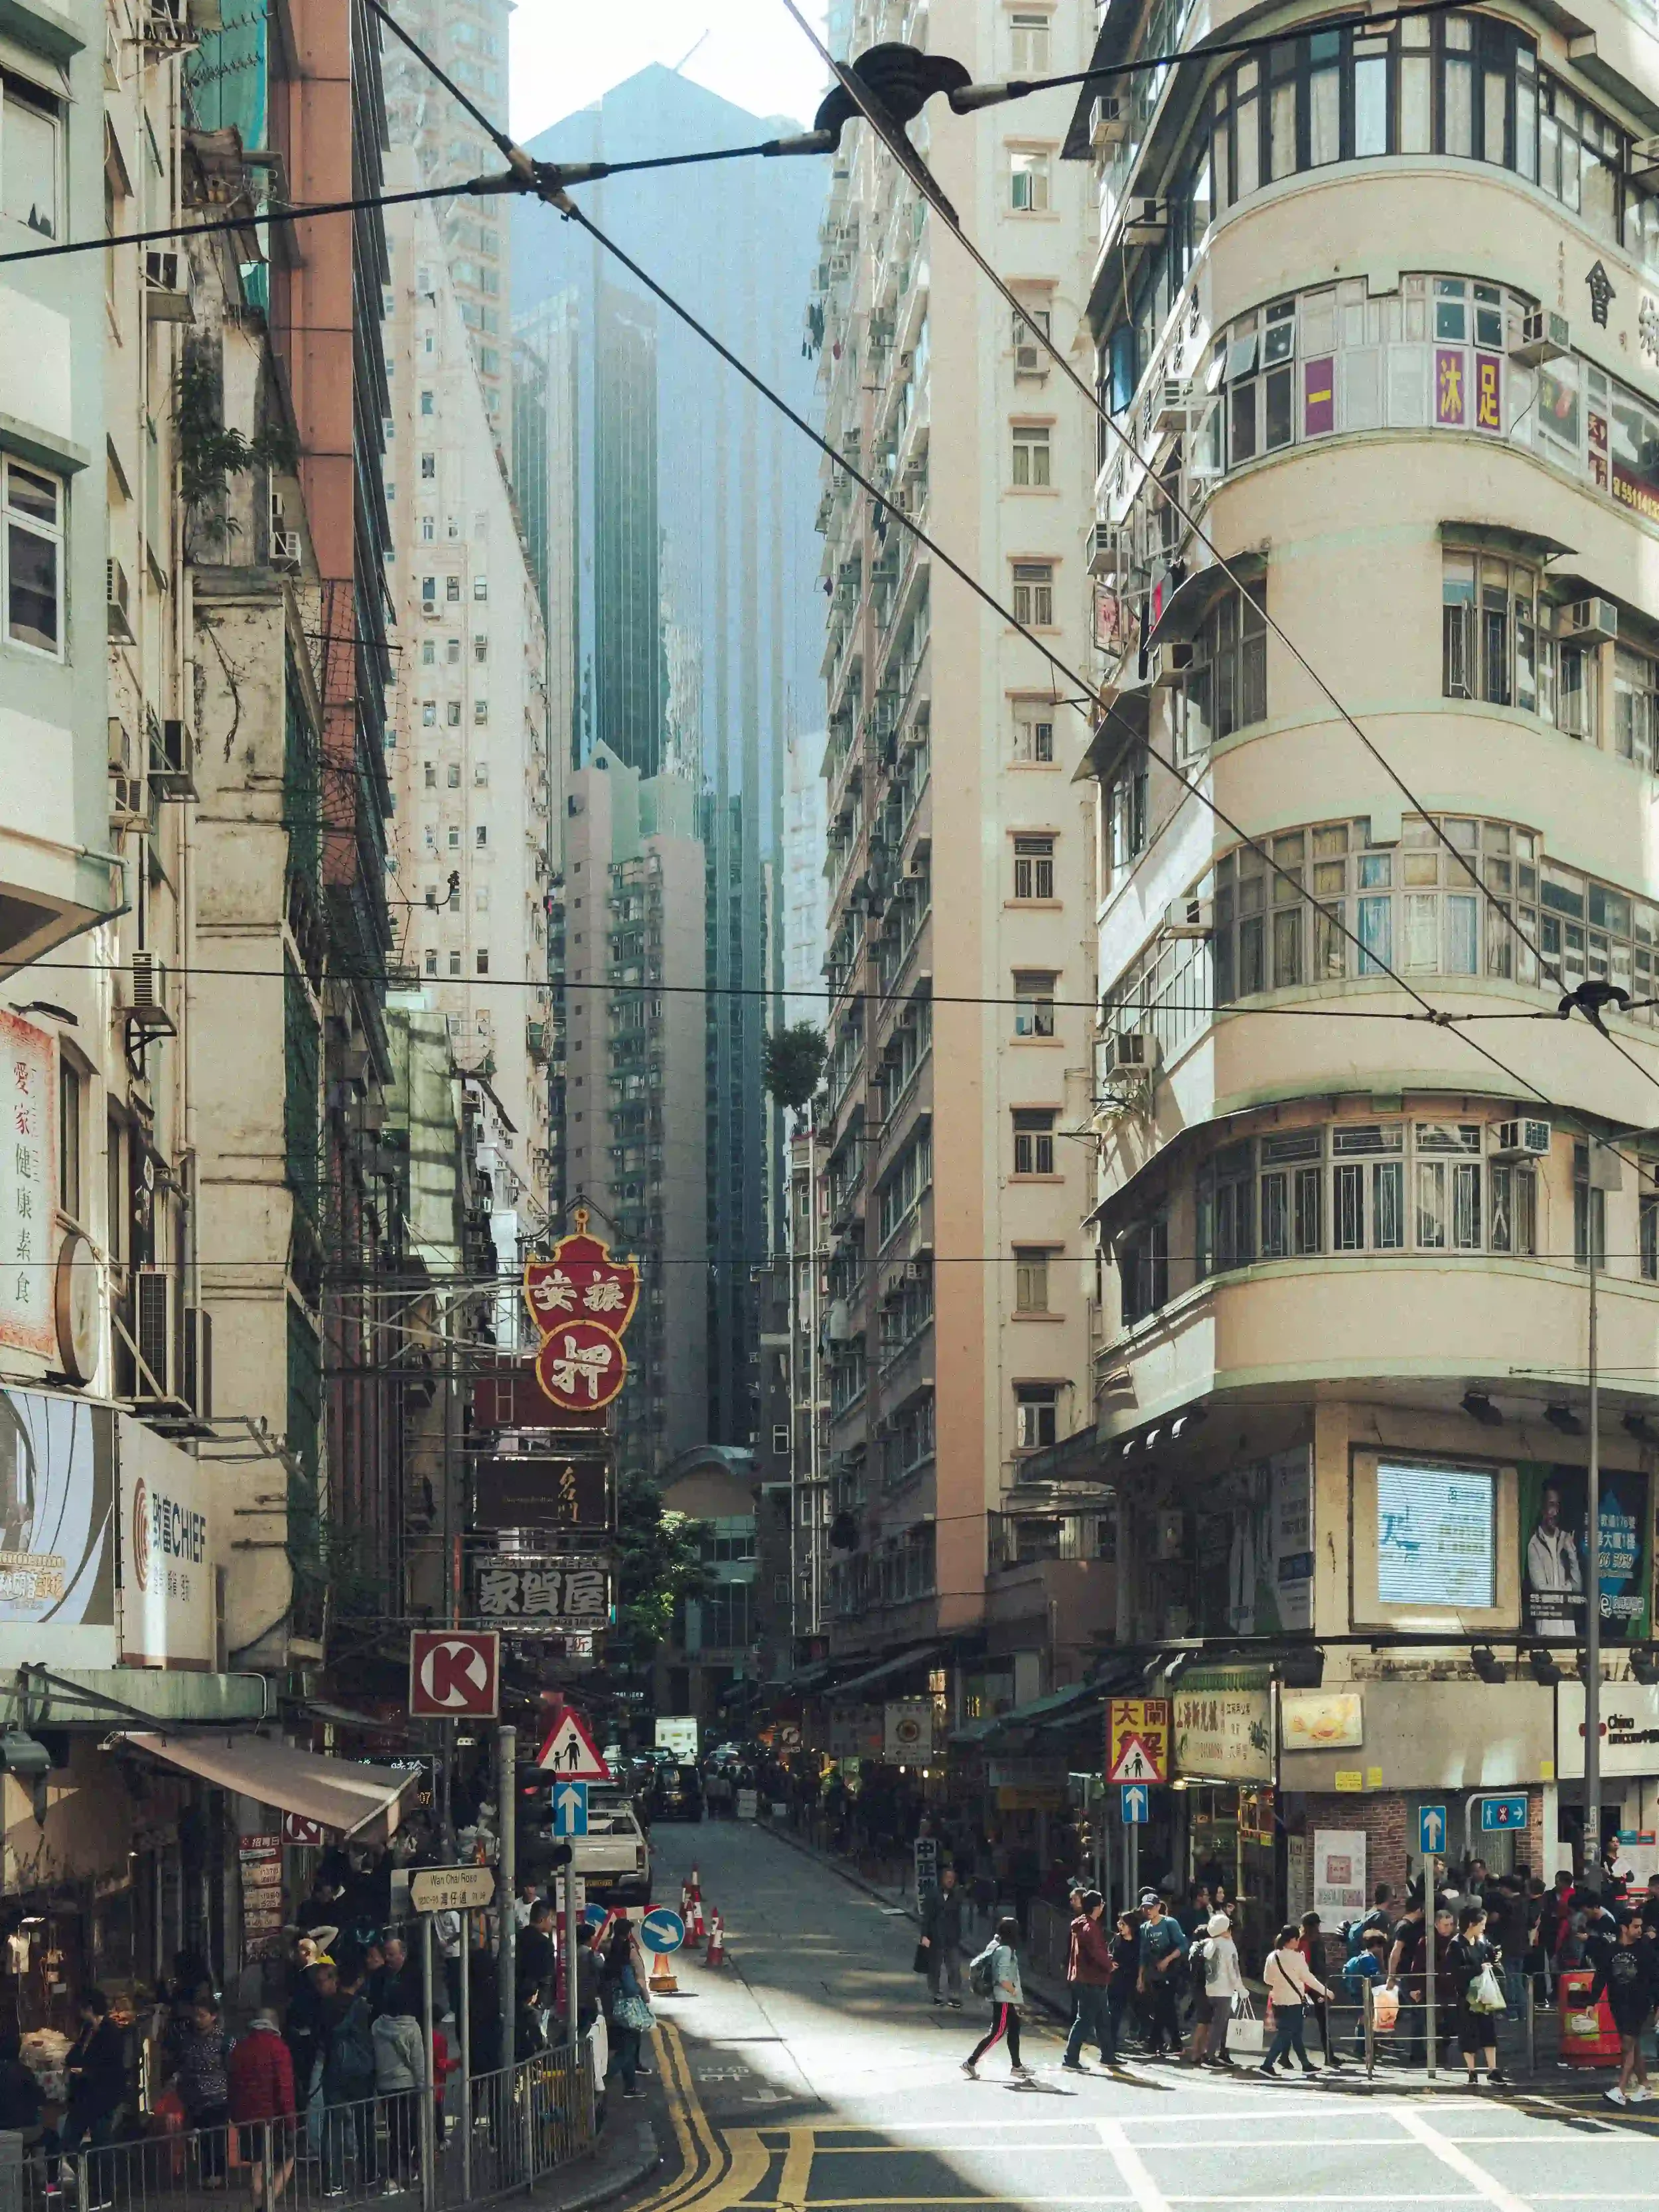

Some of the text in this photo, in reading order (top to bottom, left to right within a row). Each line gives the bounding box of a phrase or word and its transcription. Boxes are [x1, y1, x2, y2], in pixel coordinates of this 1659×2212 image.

[13, 1062, 33, 1303] 愛家健康素食
[552, 1335, 611, 1400] 押
[173, 1503, 206, 1564] CHIEF
[430, 1872, 477, 1887] Wan Chai Road
